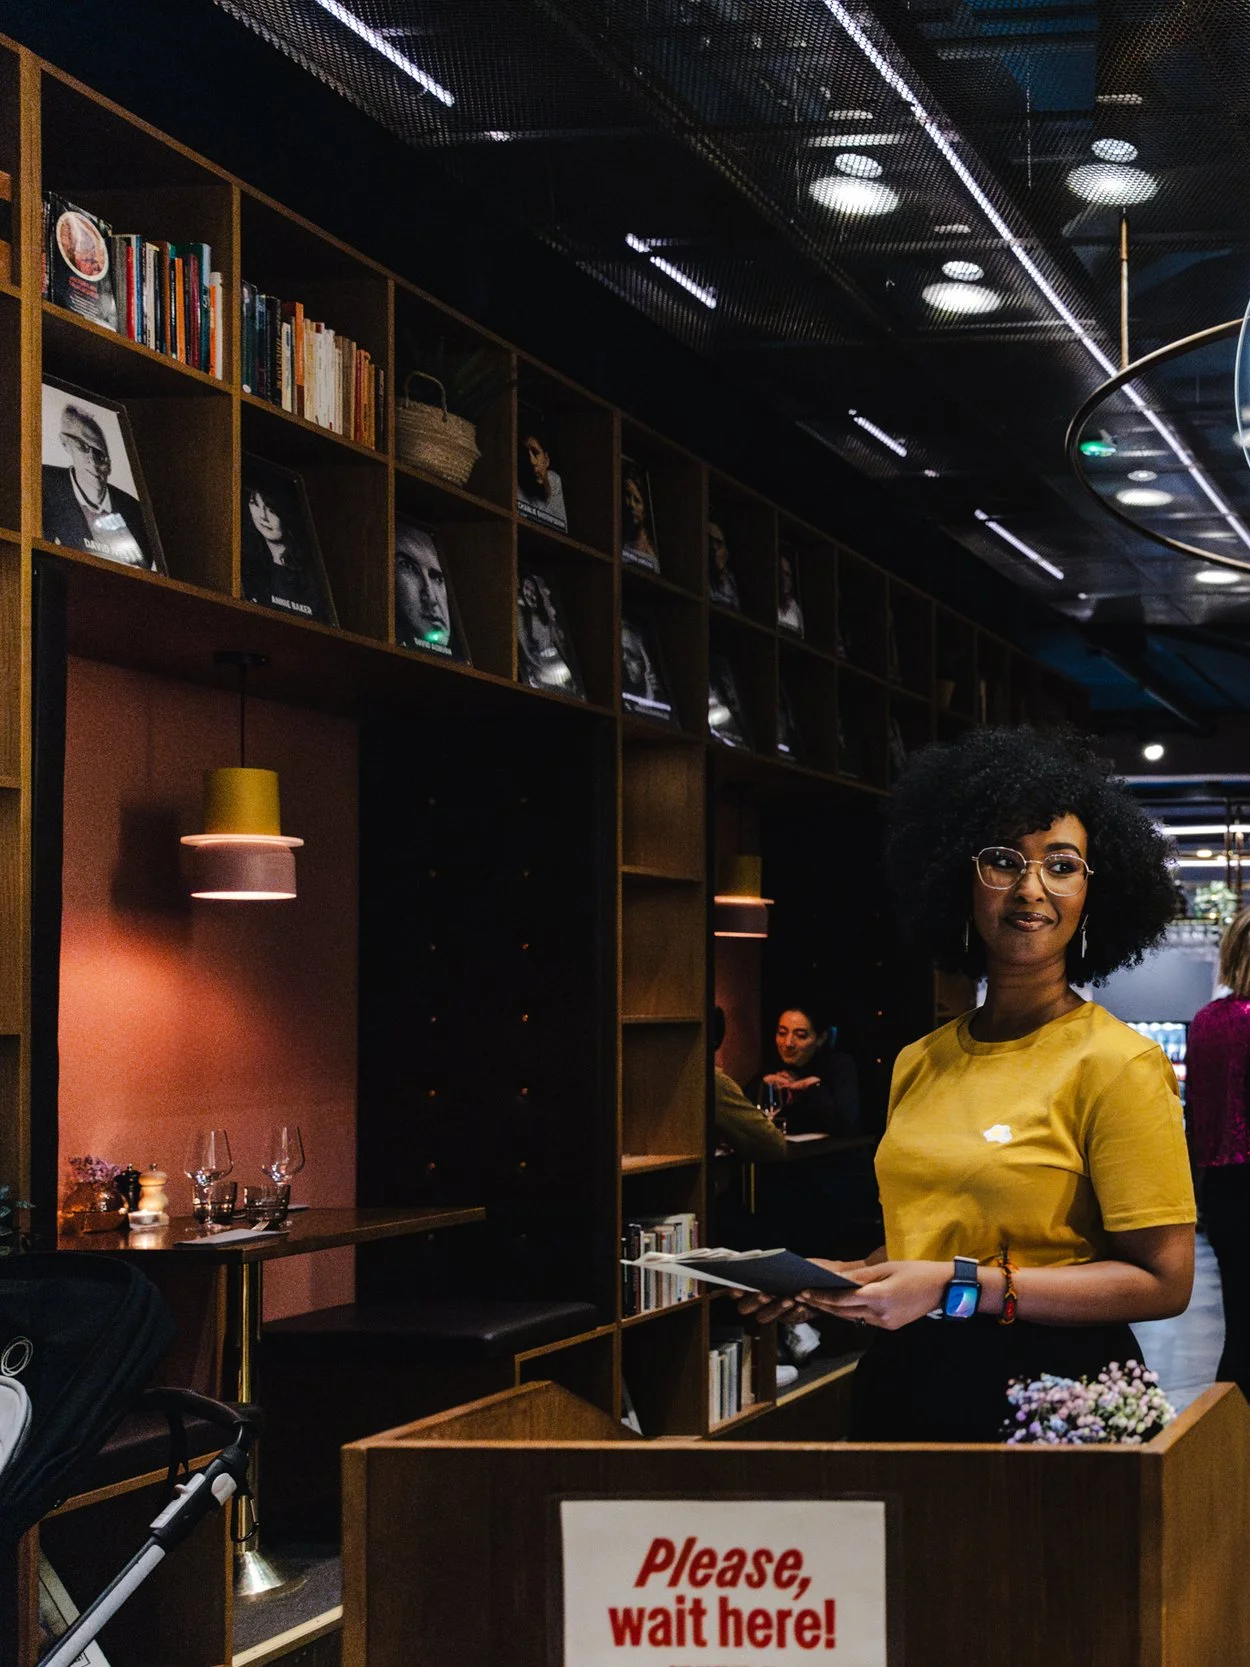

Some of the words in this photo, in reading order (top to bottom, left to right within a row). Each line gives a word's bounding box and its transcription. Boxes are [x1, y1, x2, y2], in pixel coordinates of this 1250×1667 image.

[633, 1536, 812, 1601] Please,
[608, 1595, 707, 1648] wait
[718, 1596, 837, 1650] here!
